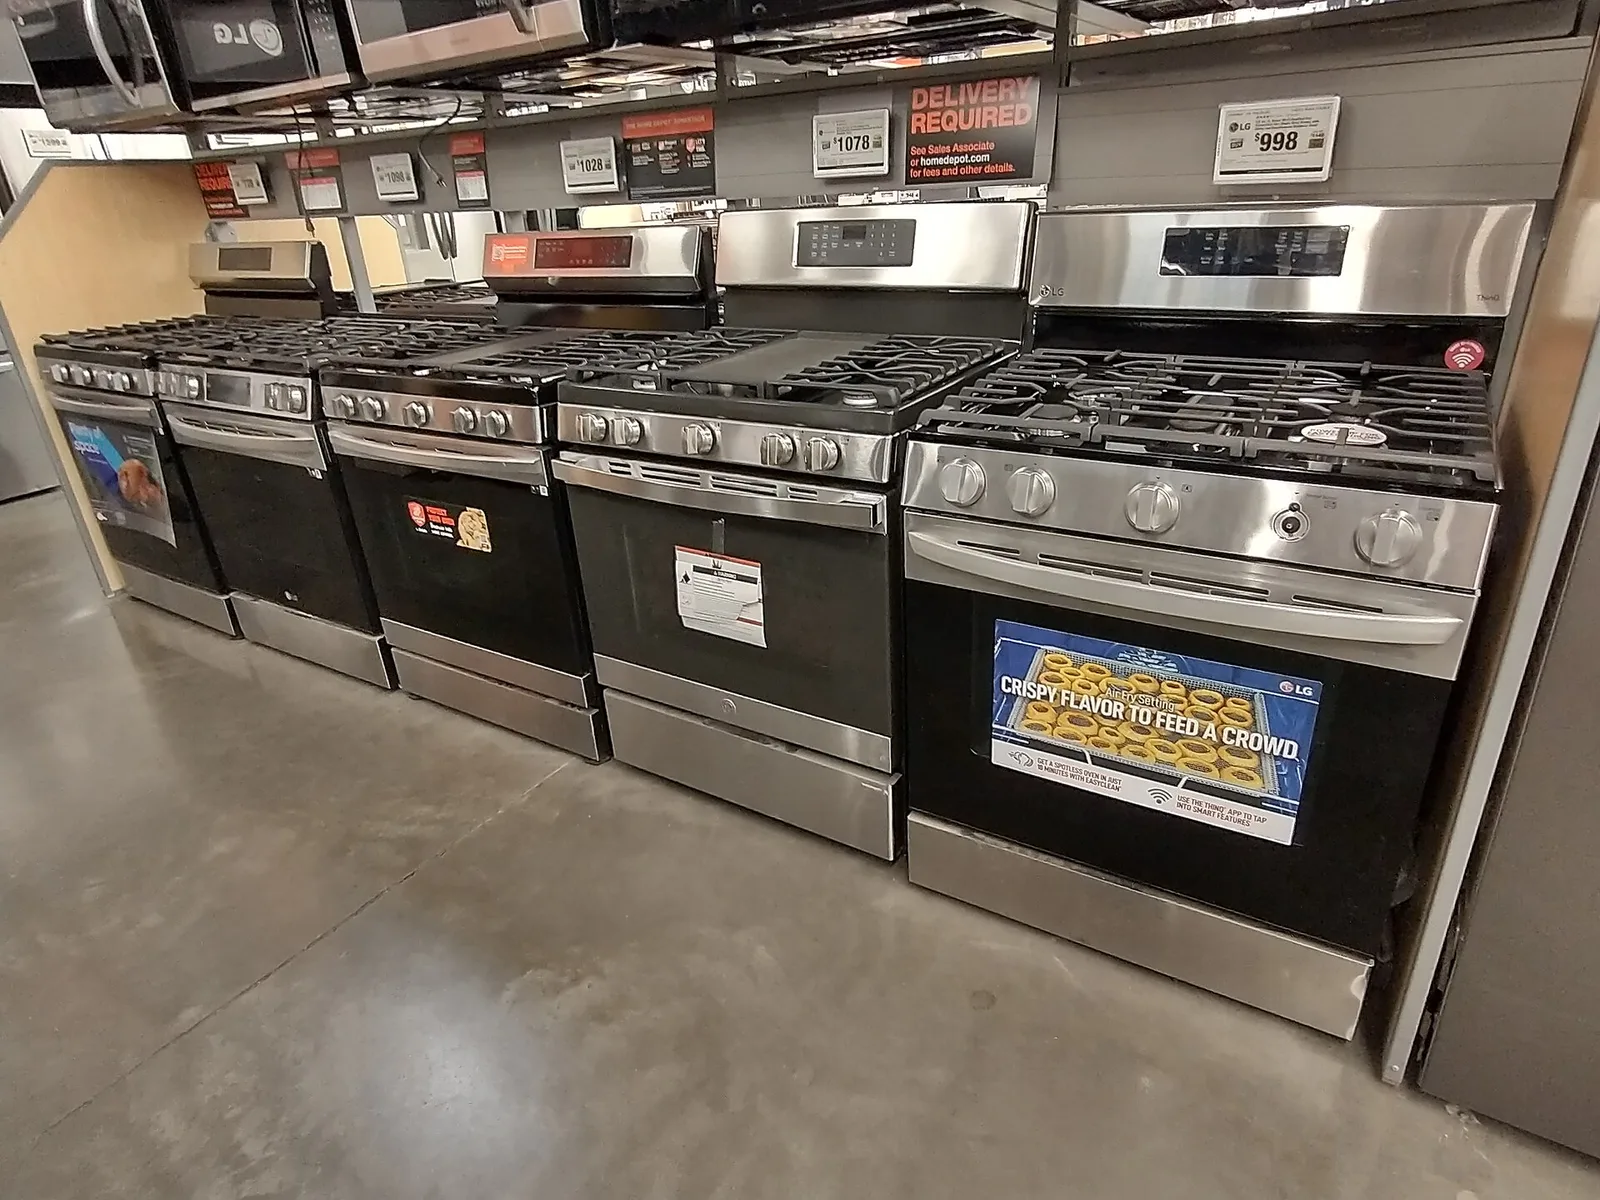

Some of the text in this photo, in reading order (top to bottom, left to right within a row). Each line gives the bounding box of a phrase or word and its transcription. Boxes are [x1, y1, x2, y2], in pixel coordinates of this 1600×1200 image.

[912, 76, 1034, 110] DELIVERY
[911, 103, 1033, 134] REQUIRED
[1240, 122, 1251, 131] LG
[833, 135, 870, 152] $1078
[910, 141, 995, 156] See Sales Associate
[1255, 131, 1298, 152] $998
[577, 158, 603, 172] $1028
[910, 153, 990, 167] or homedepot.com
[910, 162, 1016, 178] for fees and other details.
[1052, 286, 1065, 297] LG
[1295, 684, 1313, 697] LG
[1105, 686, 1176, 713] Air Fry Setting
[1001, 675, 1299, 761] CRISPY FLAVOR TO FEED A CROWD
[1038, 757, 1048, 766] GET
[1054, 762, 1084, 775] SPOTLESS
[1084, 769, 1100, 780] OVEN
[1100, 773, 1107, 781] IN
[1107, 776, 1122, 786] JUST
[1044, 766, 1069, 778] MINUTES
[1070, 772, 1085, 782] WITH
[1176, 802, 1251, 827] INTO SMART FEATURES
[1177, 794, 1191, 804] USE
[1191, 798, 1203, 807] THE
[1227, 808, 1242, 817] APP
[1243, 813, 1252, 821] TO
[1253, 814, 1267, 824] TAP
